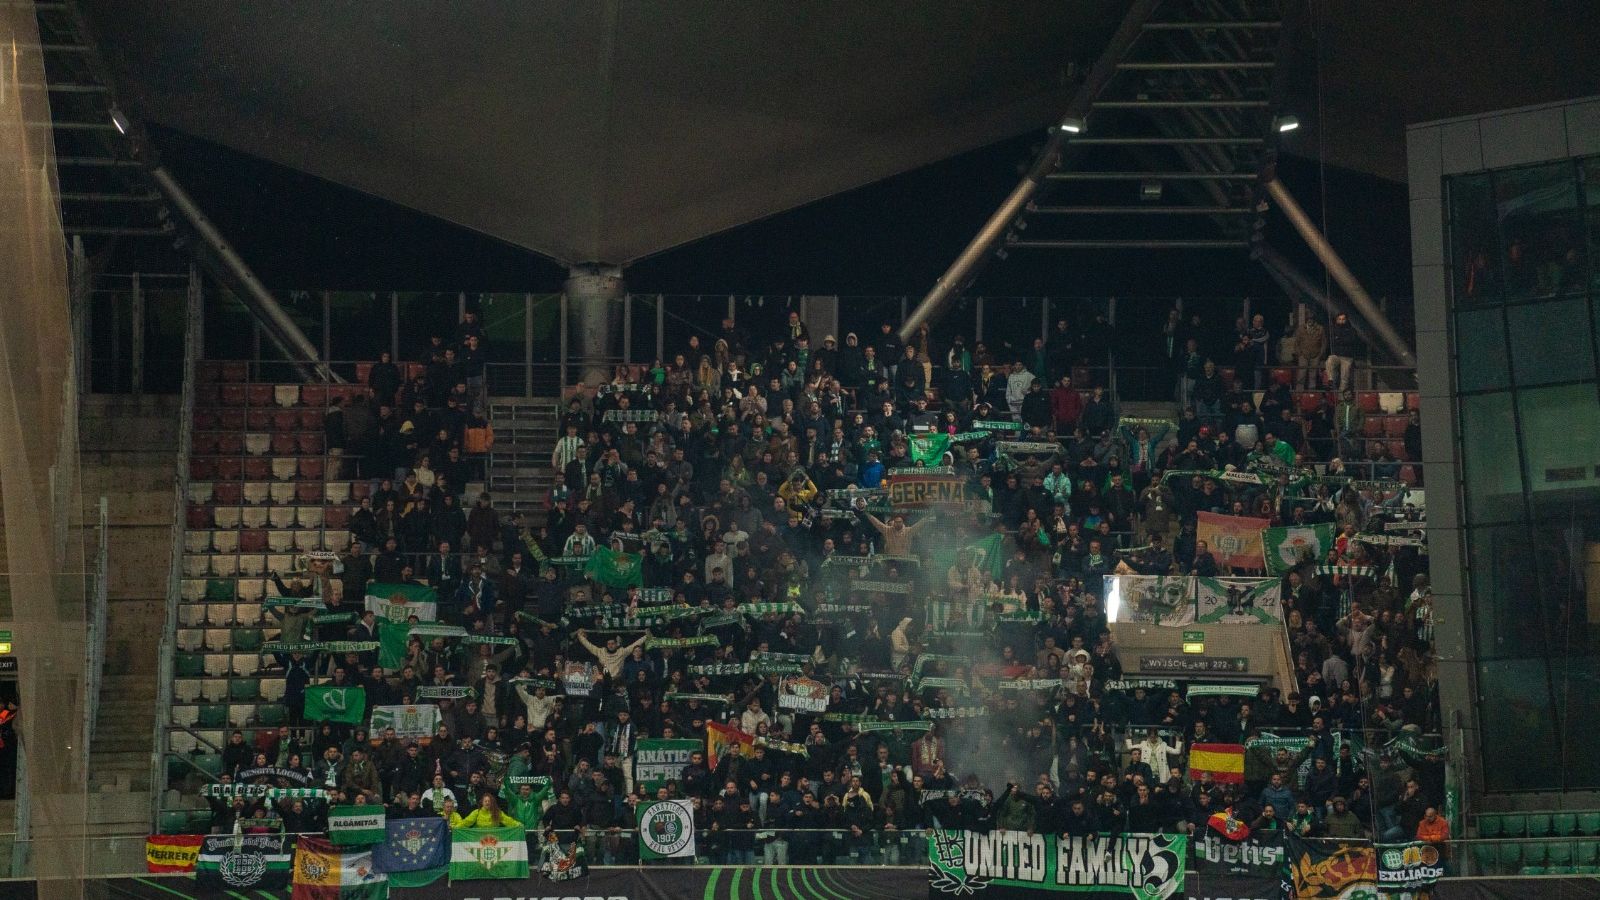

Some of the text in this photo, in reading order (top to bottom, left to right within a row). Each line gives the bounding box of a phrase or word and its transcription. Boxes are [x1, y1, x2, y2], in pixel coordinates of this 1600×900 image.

[1225, 471, 1257, 482] MALLORCA
[892, 481, 964, 503] GERENA
[1204, 596, 1218, 605] 20
[1262, 597, 1276, 606] 22
[440, 687, 463, 696] Betis
[638, 748, 690, 763] ANÁTIC
[333, 818, 378, 827] ALGÁMITAS
[656, 834, 676, 843] 1907
[147, 848, 198, 861] HERRERA
[963, 829, 1047, 883] UNITED
[1055, 834, 1151, 888] FAMILY
[1378, 866, 1444, 882] EXILIADOS
